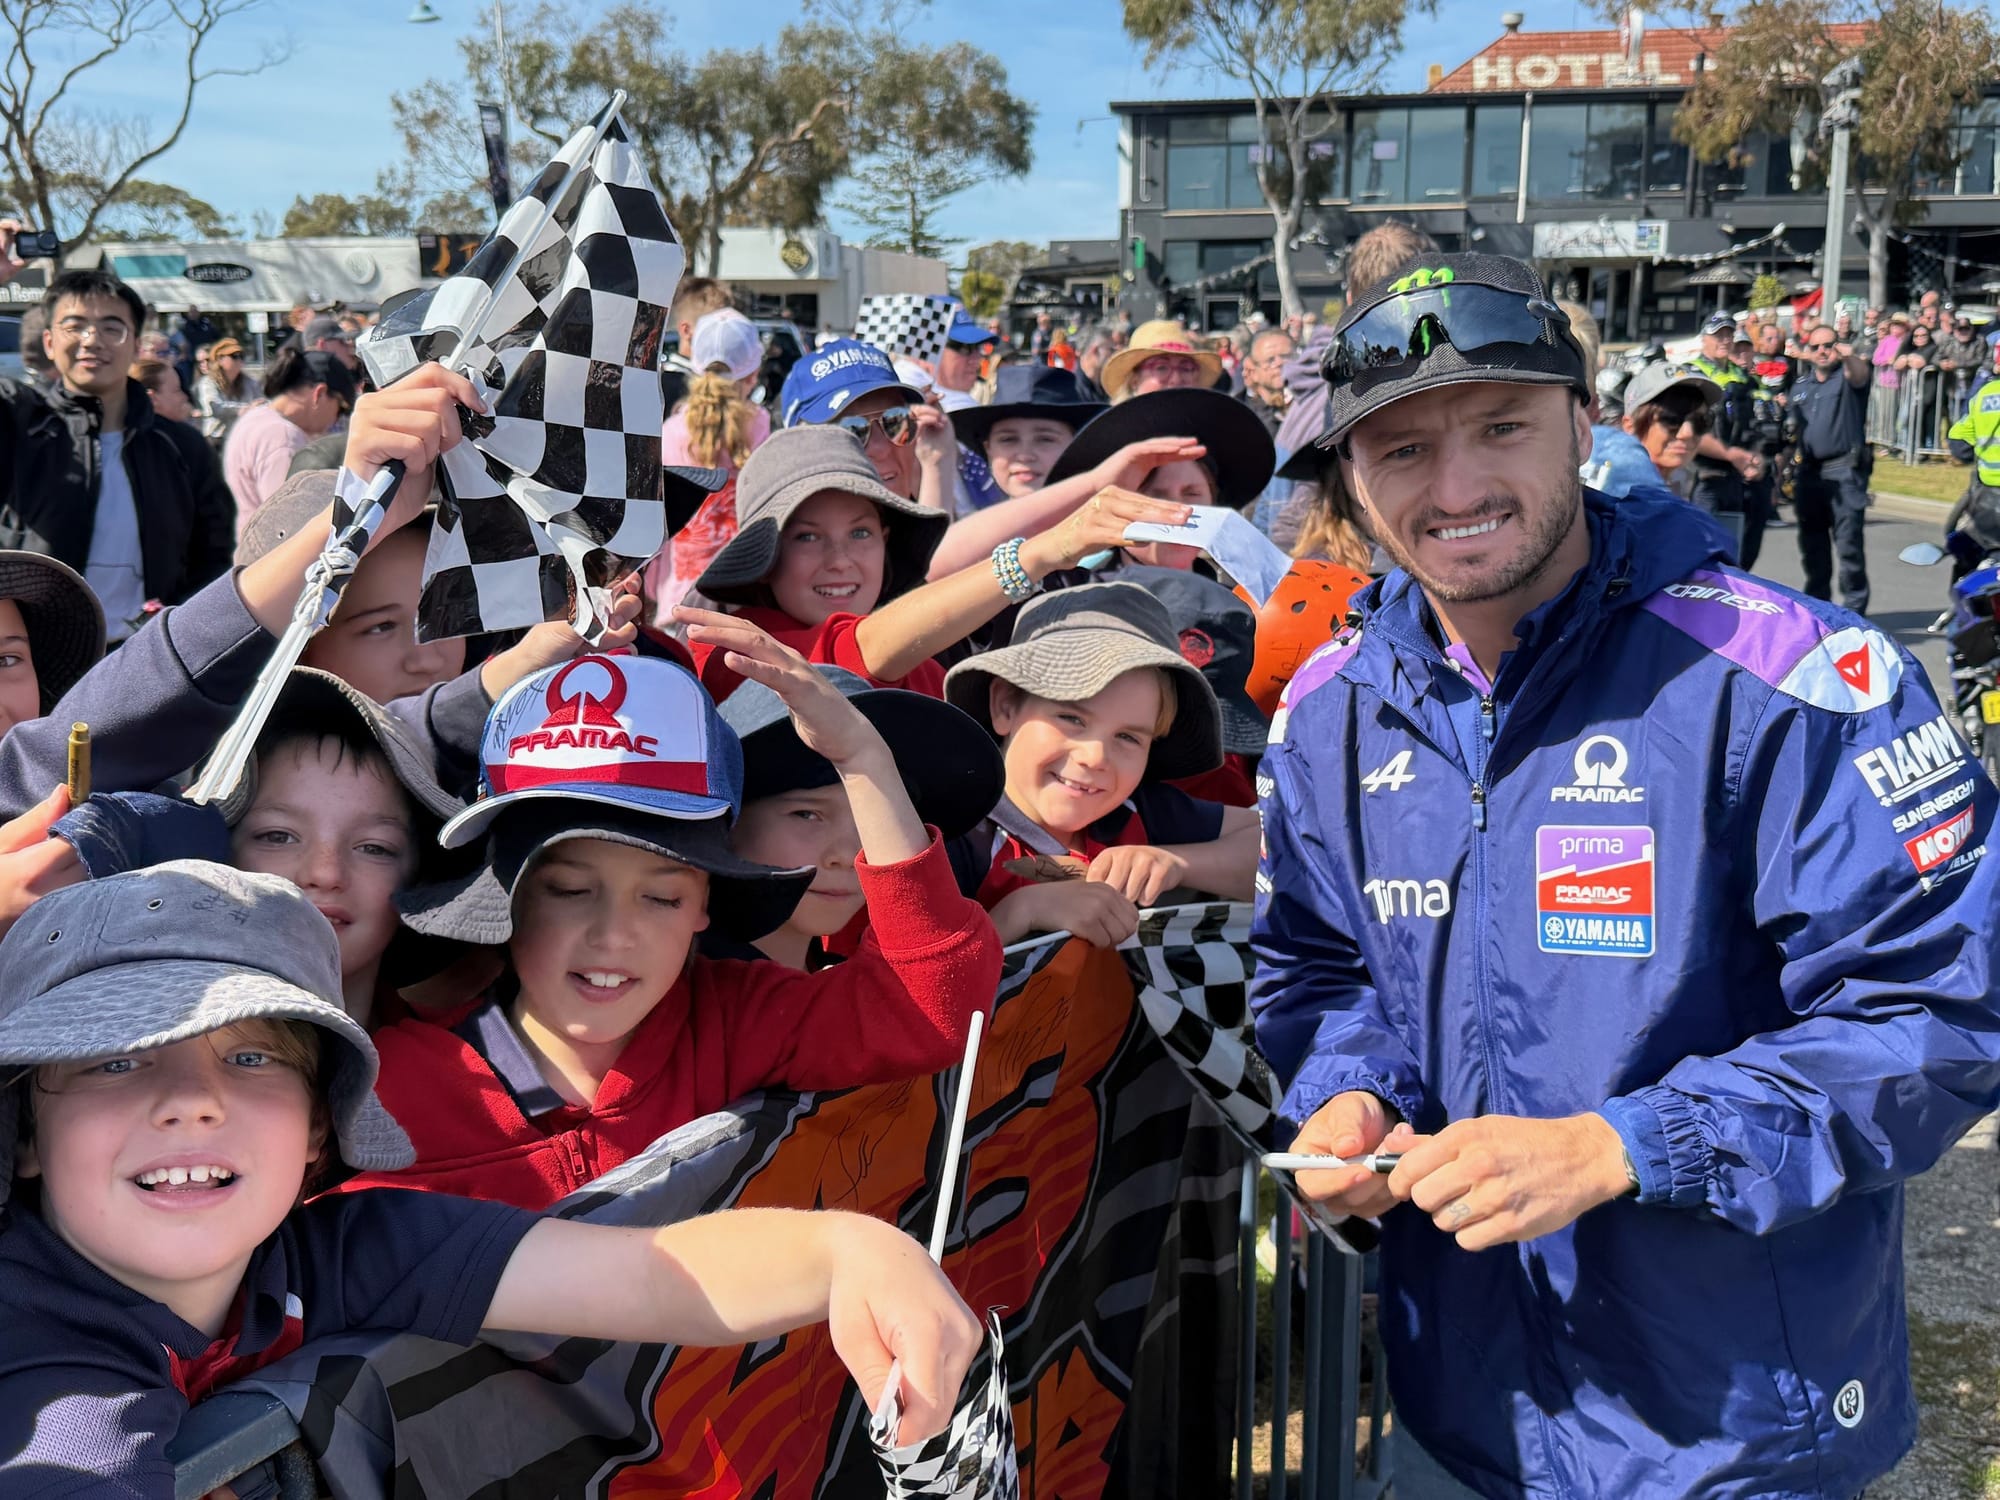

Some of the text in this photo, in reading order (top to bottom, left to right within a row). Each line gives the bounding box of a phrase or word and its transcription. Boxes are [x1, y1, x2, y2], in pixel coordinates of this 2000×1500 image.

[1472, 52, 1681, 88] HOTEL
[1663, 583, 1785, 616] DAINESE
[508, 728, 659, 759] PRAMAC
[1853, 715, 1963, 798] FIAMM
[1551, 786, 1645, 803] PRAMAC
[1558, 836, 1624, 859] prima
[1555, 885, 1632, 899] PRAMAC
[1545, 938, 1594, 946] FACTORY
[1565, 918, 1645, 942] YAMAHA
